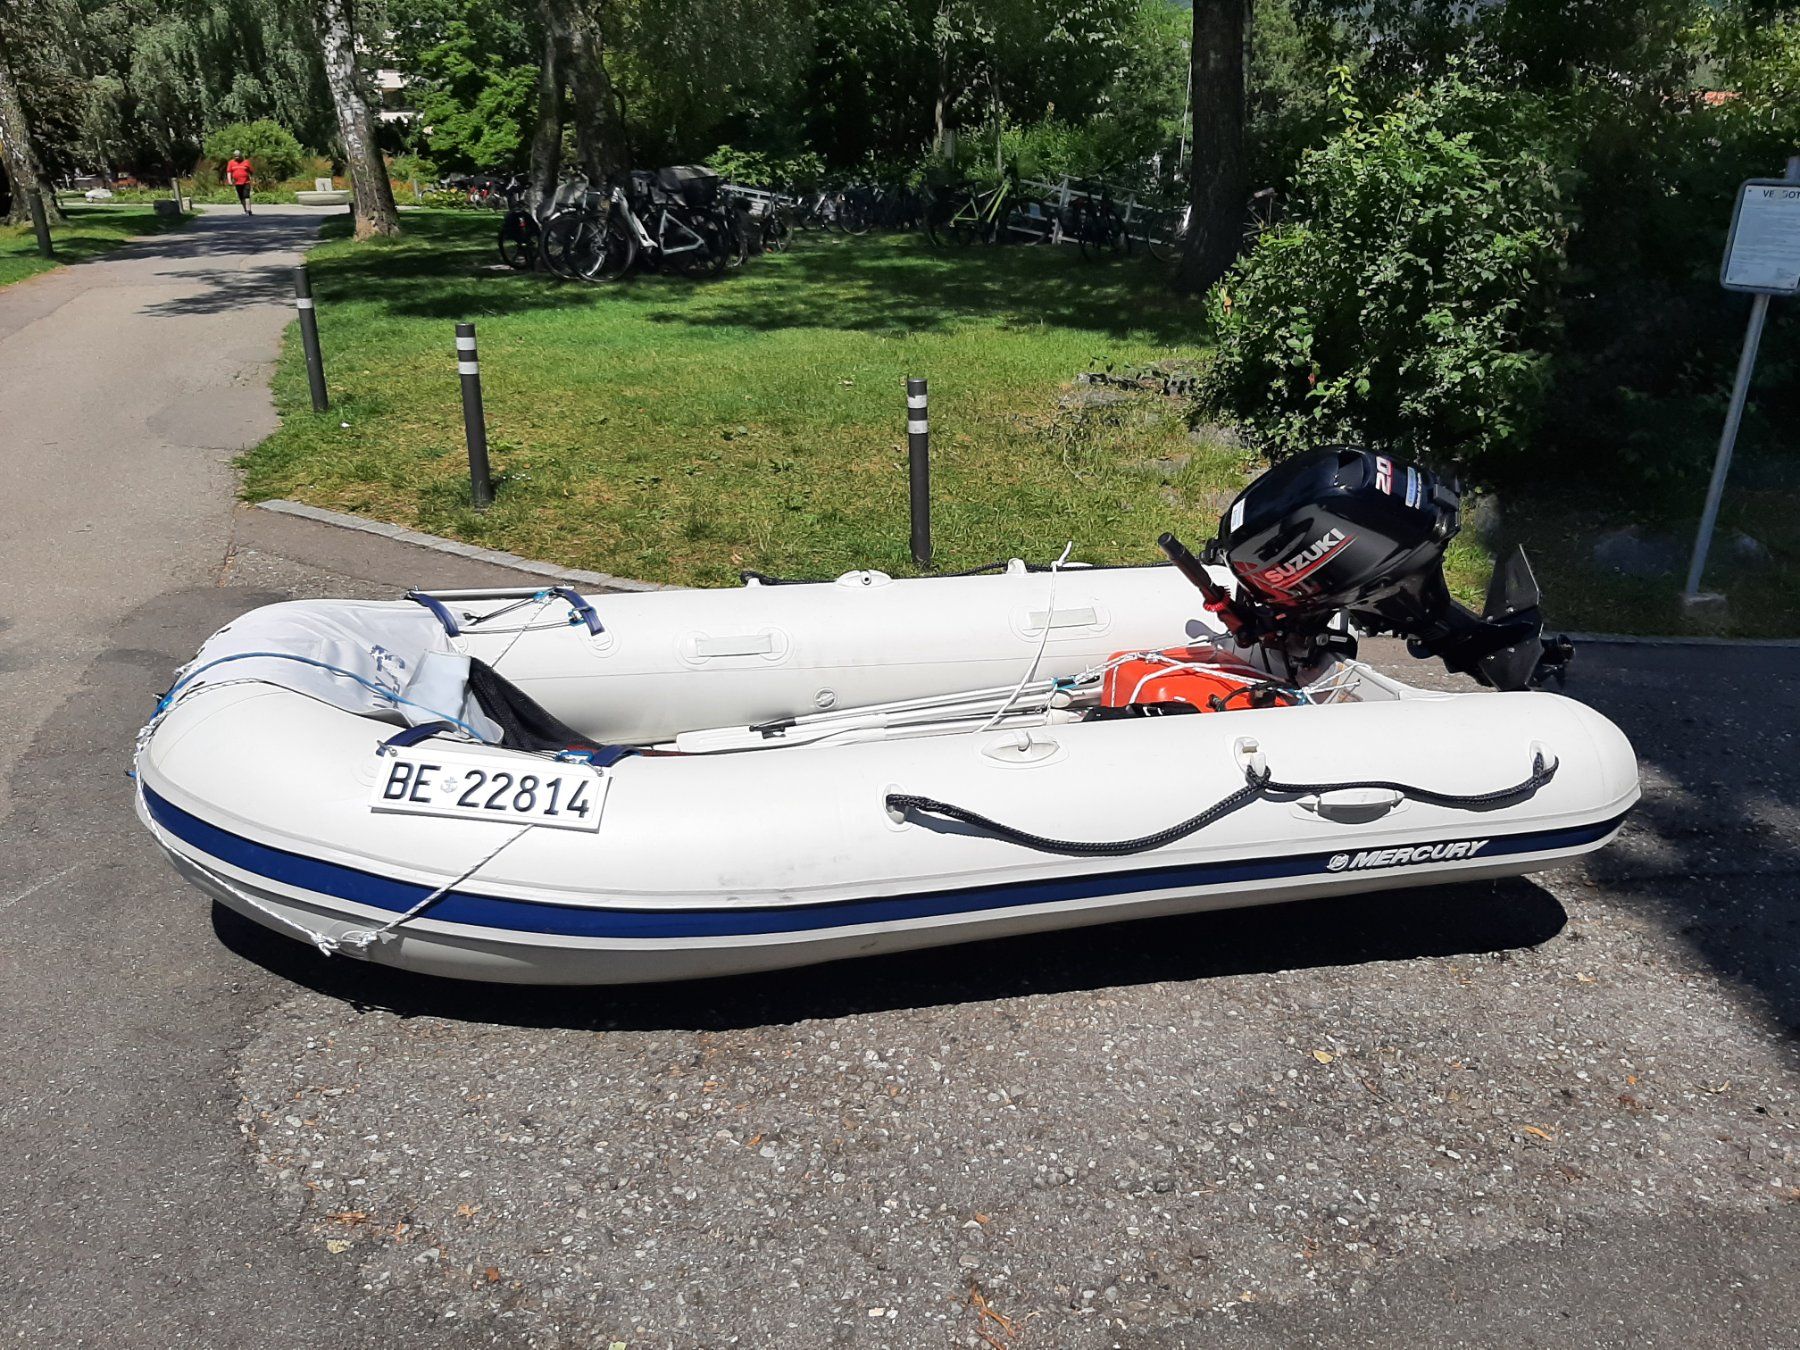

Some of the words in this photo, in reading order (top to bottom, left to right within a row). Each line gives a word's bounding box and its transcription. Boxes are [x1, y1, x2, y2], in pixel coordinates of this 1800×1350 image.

[1375, 455, 1394, 496] 20
[1264, 527, 1346, 584] SUZUKI
[383, 761, 441, 803] BE
[456, 769, 589, 818] 22814
[1349, 839, 1490, 869] MERCURY
